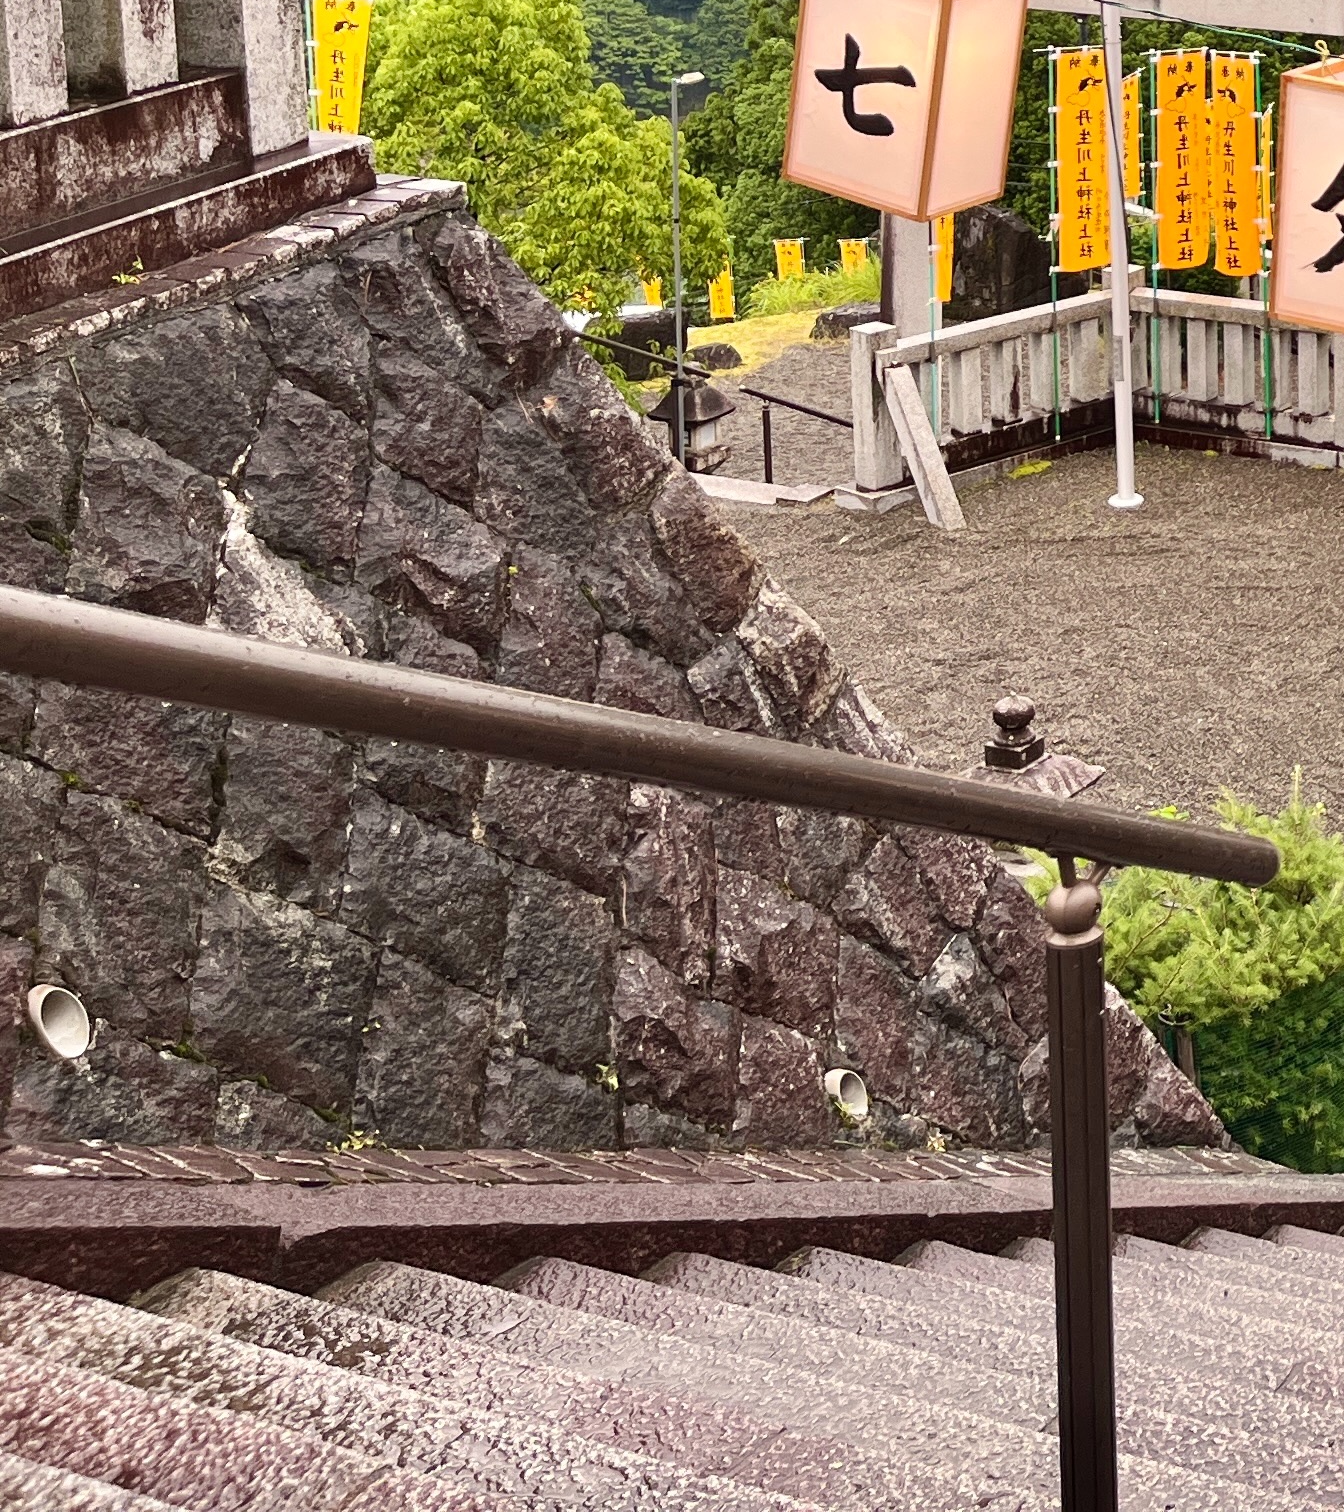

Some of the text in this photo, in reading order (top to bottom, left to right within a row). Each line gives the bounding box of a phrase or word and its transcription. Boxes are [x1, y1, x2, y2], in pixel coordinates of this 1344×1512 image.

[815, 35, 916, 136] 七
[1222, 121, 1242, 270] 丹生川上神社上社
